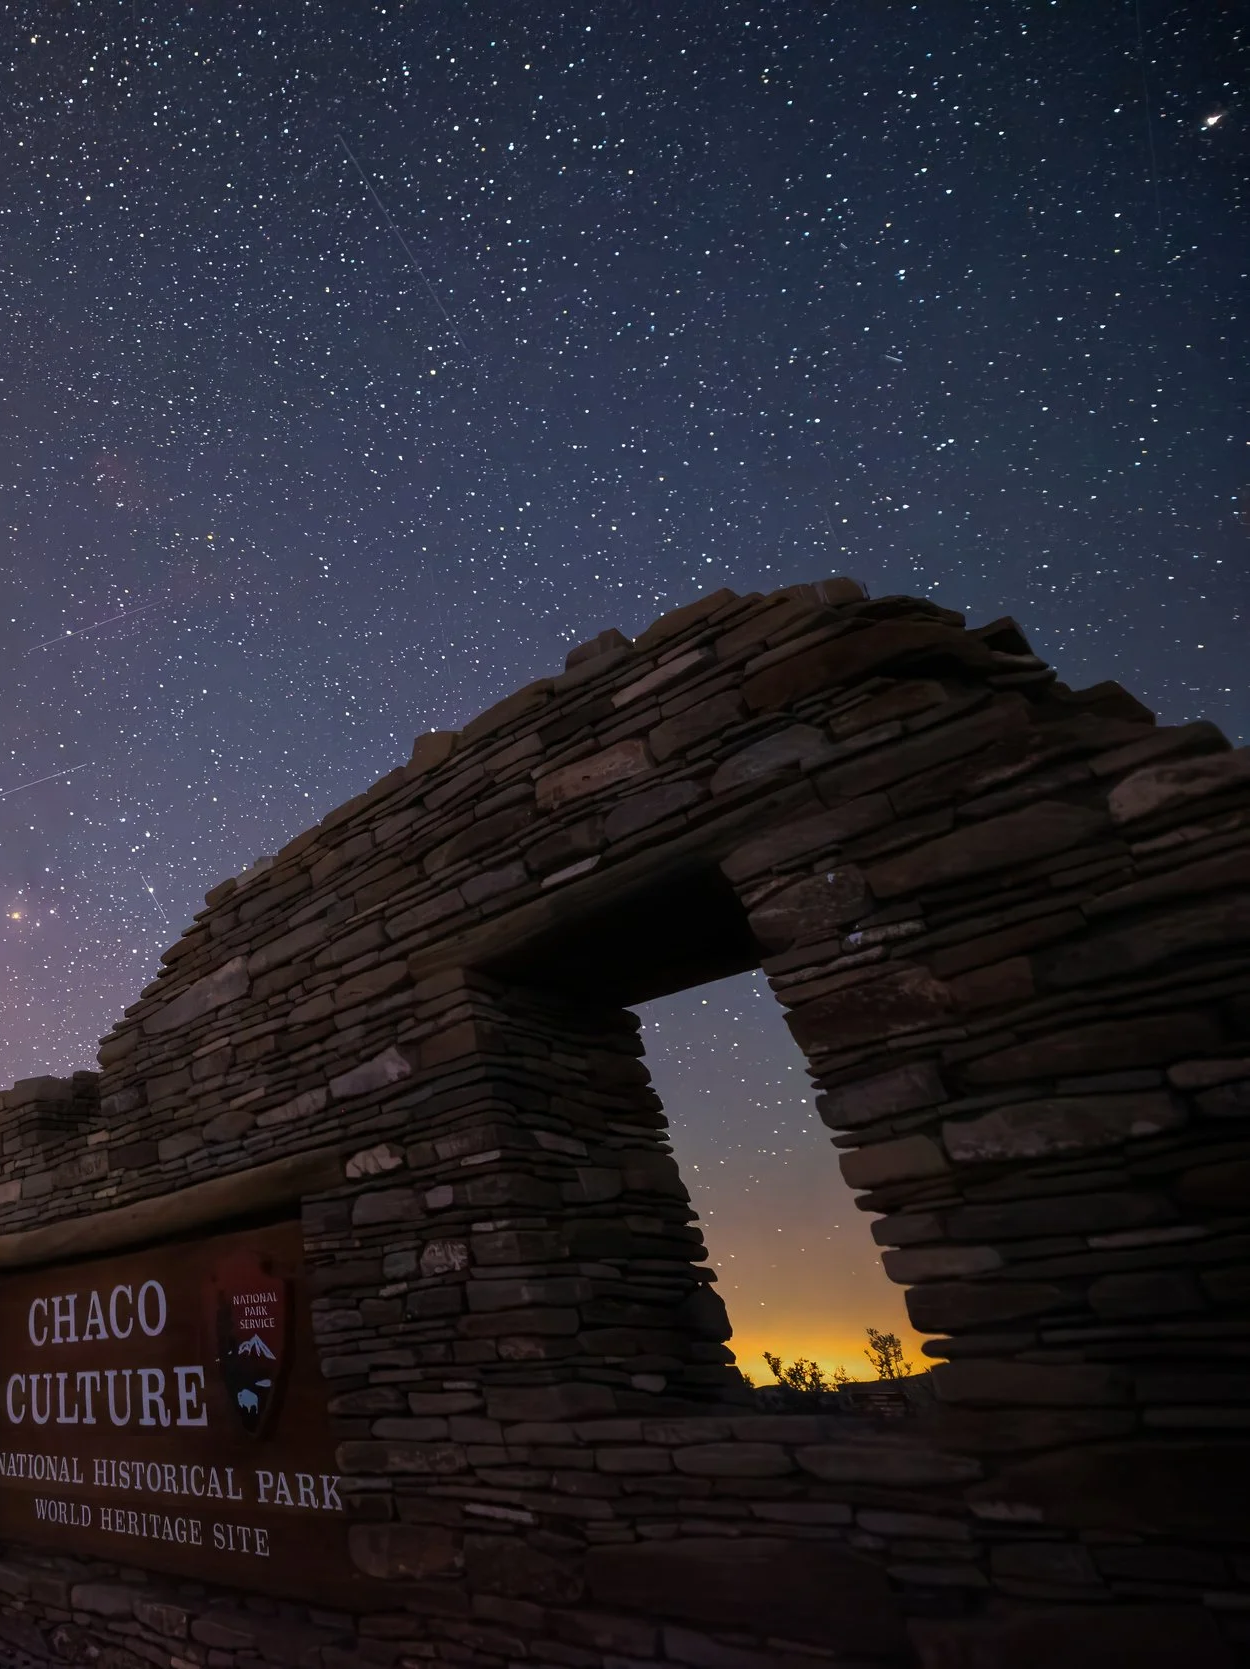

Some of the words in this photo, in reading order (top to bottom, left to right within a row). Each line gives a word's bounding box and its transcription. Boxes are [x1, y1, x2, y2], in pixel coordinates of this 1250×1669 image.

[29, 1280, 166, 1346] CHACO
[233, 1291, 279, 1306] NATIONAL
[239, 1317, 276, 1330] SERVICE
[244, 1305, 270, 1317] PARK
[7, 1366, 207, 1427] CULTURE
[94, 1459, 242, 1499] HISTORICAL
[256, 1471, 343, 1510] PARK
[36, 1499, 92, 1526] WORLD
[100, 1508, 202, 1545] HERITAGE
[214, 1523, 269, 1556] SITE
